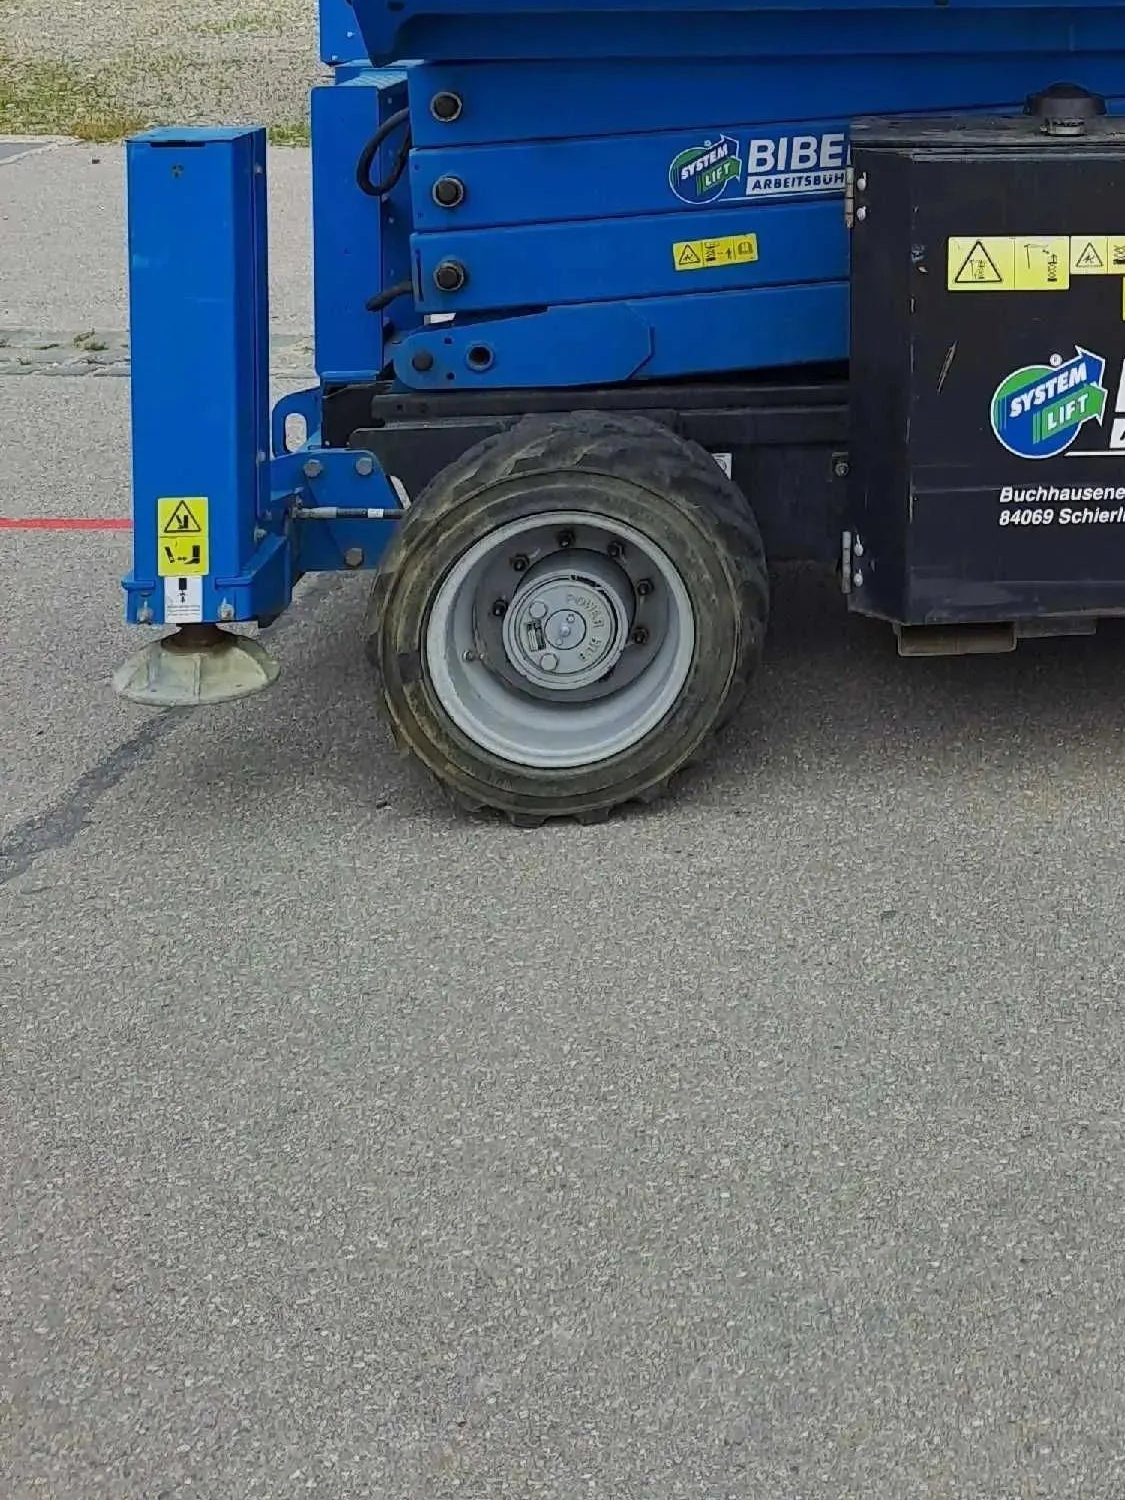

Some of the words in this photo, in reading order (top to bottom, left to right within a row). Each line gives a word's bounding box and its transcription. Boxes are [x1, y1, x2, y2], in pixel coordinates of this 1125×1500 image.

[680, 142, 729, 181] SYSTEM
[747, 133, 850, 174] BIBE
[704, 162, 732, 188] LIFT
[1009, 361, 1088, 417] SYSTEM
[1046, 392, 1089, 431] LIFT
[999, 508, 1054, 526] 84069
